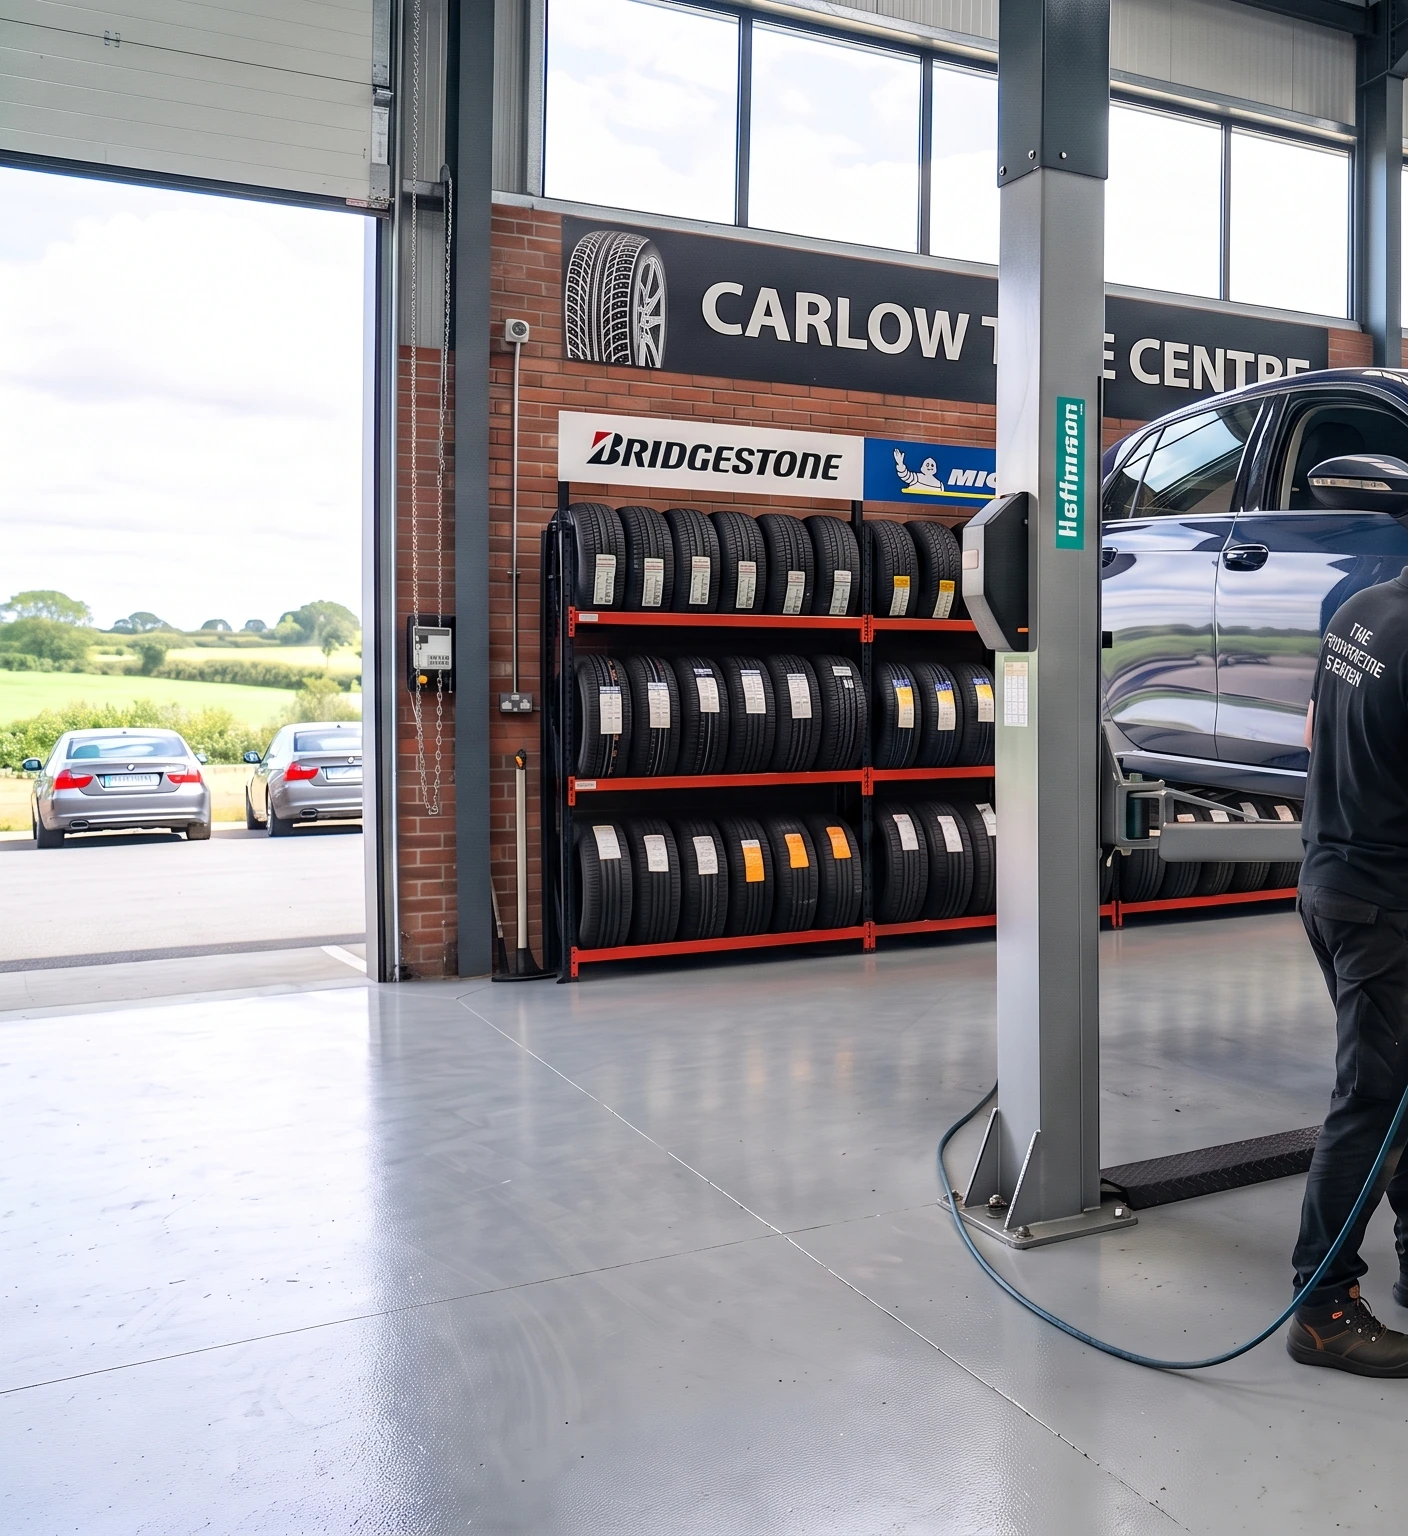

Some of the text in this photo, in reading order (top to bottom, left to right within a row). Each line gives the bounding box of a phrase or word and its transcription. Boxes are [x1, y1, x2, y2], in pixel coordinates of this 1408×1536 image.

[701, 281, 970, 361] CARLOW
[586, 431, 843, 481] BRIDGESTONE
[947, 468, 996, 489] MIC
